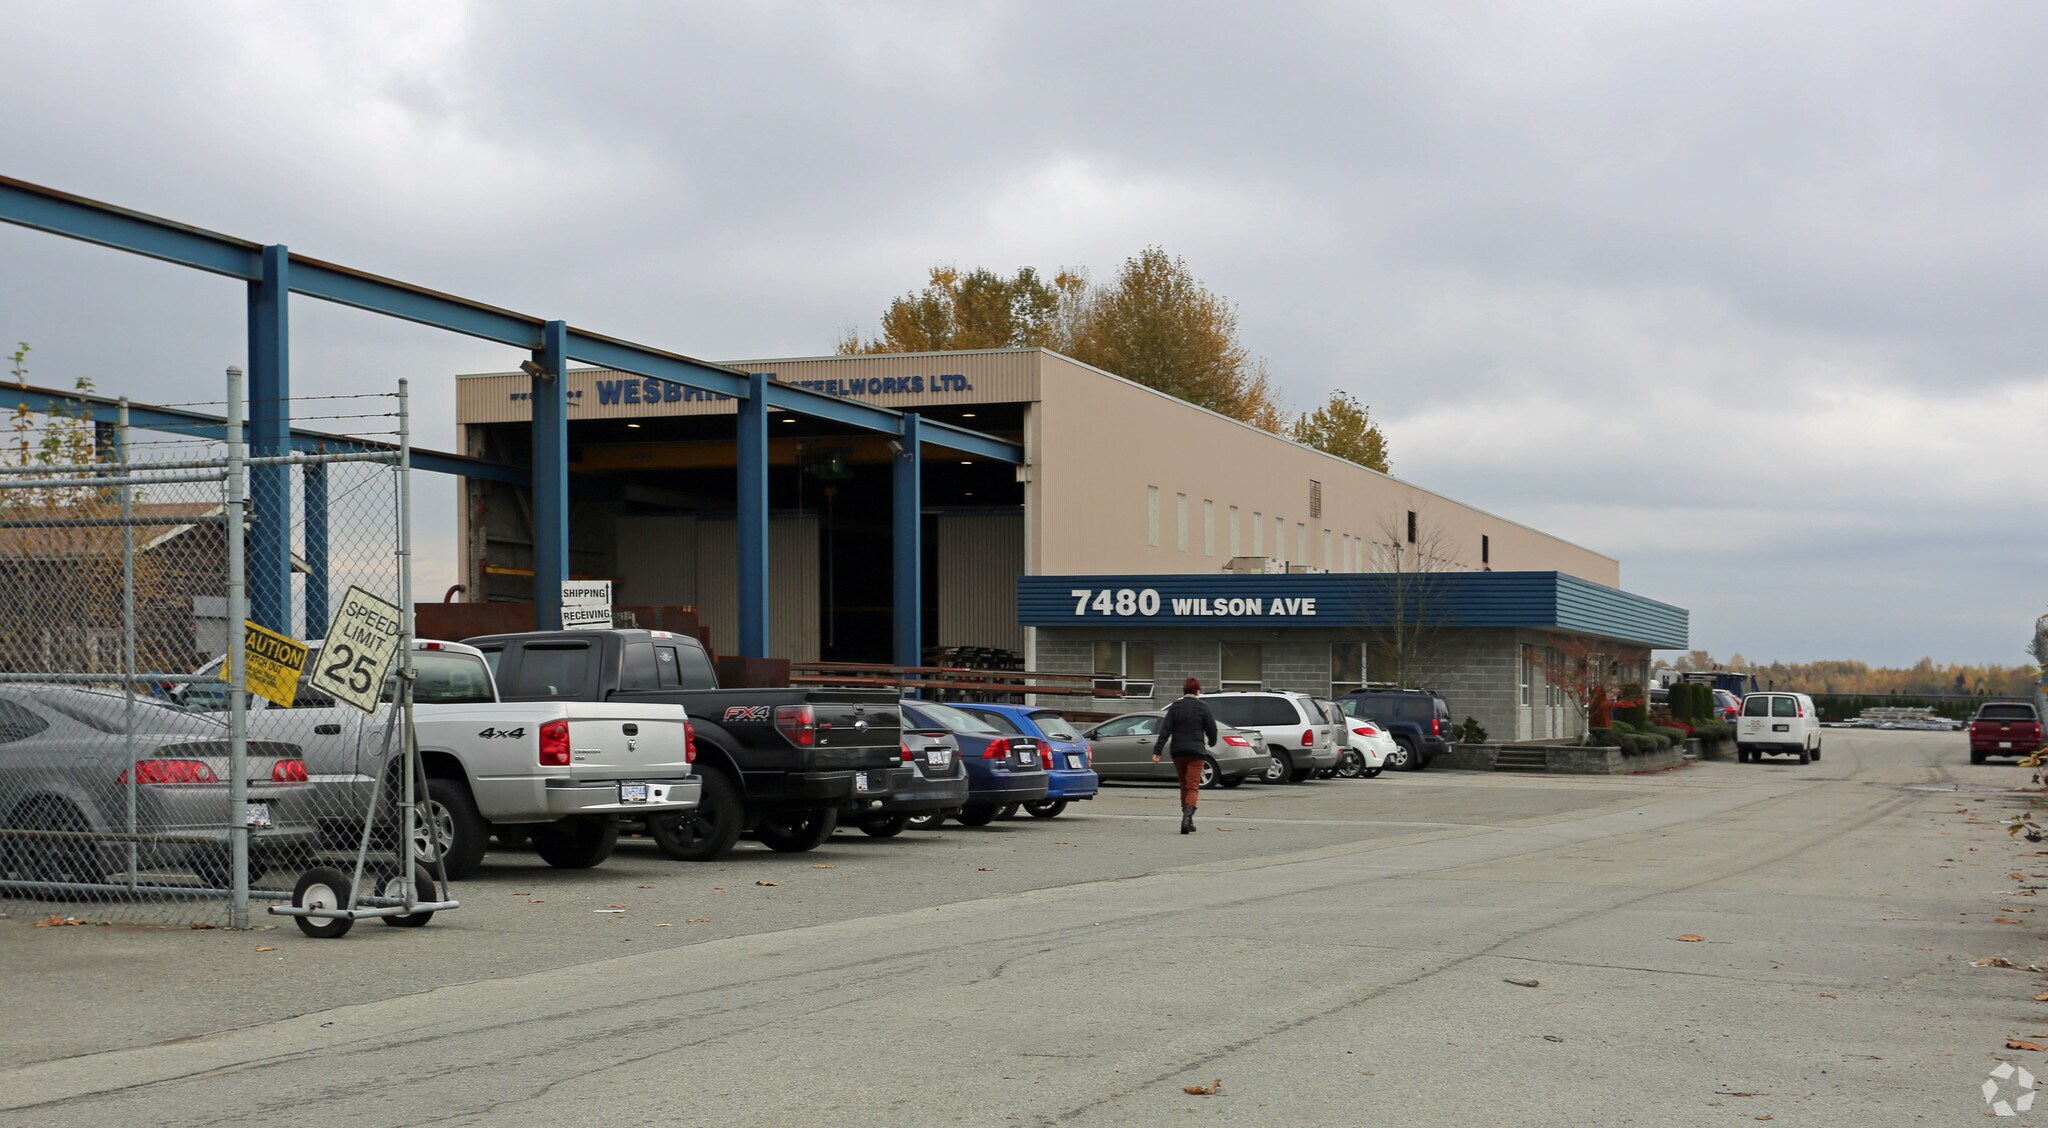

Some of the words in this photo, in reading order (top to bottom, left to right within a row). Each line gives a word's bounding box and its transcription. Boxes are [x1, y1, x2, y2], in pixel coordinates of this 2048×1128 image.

[930, 374, 973, 393] LTD.
[563, 588, 605, 598] SHIPPING
[1071, 588, 1161, 616] 7480
[1171, 598, 1262, 616] WILSON
[1268, 598, 1317, 616] AVE
[345, 600, 399, 637] SPEED
[563, 609, 610, 620] RECEIVING
[244, 628, 303, 667] AUTION
[343, 621, 387, 652] LIMIT
[324, 643, 378, 694] 25
[724, 705, 771, 719] FX4
[477, 727, 527, 740] 4x4
